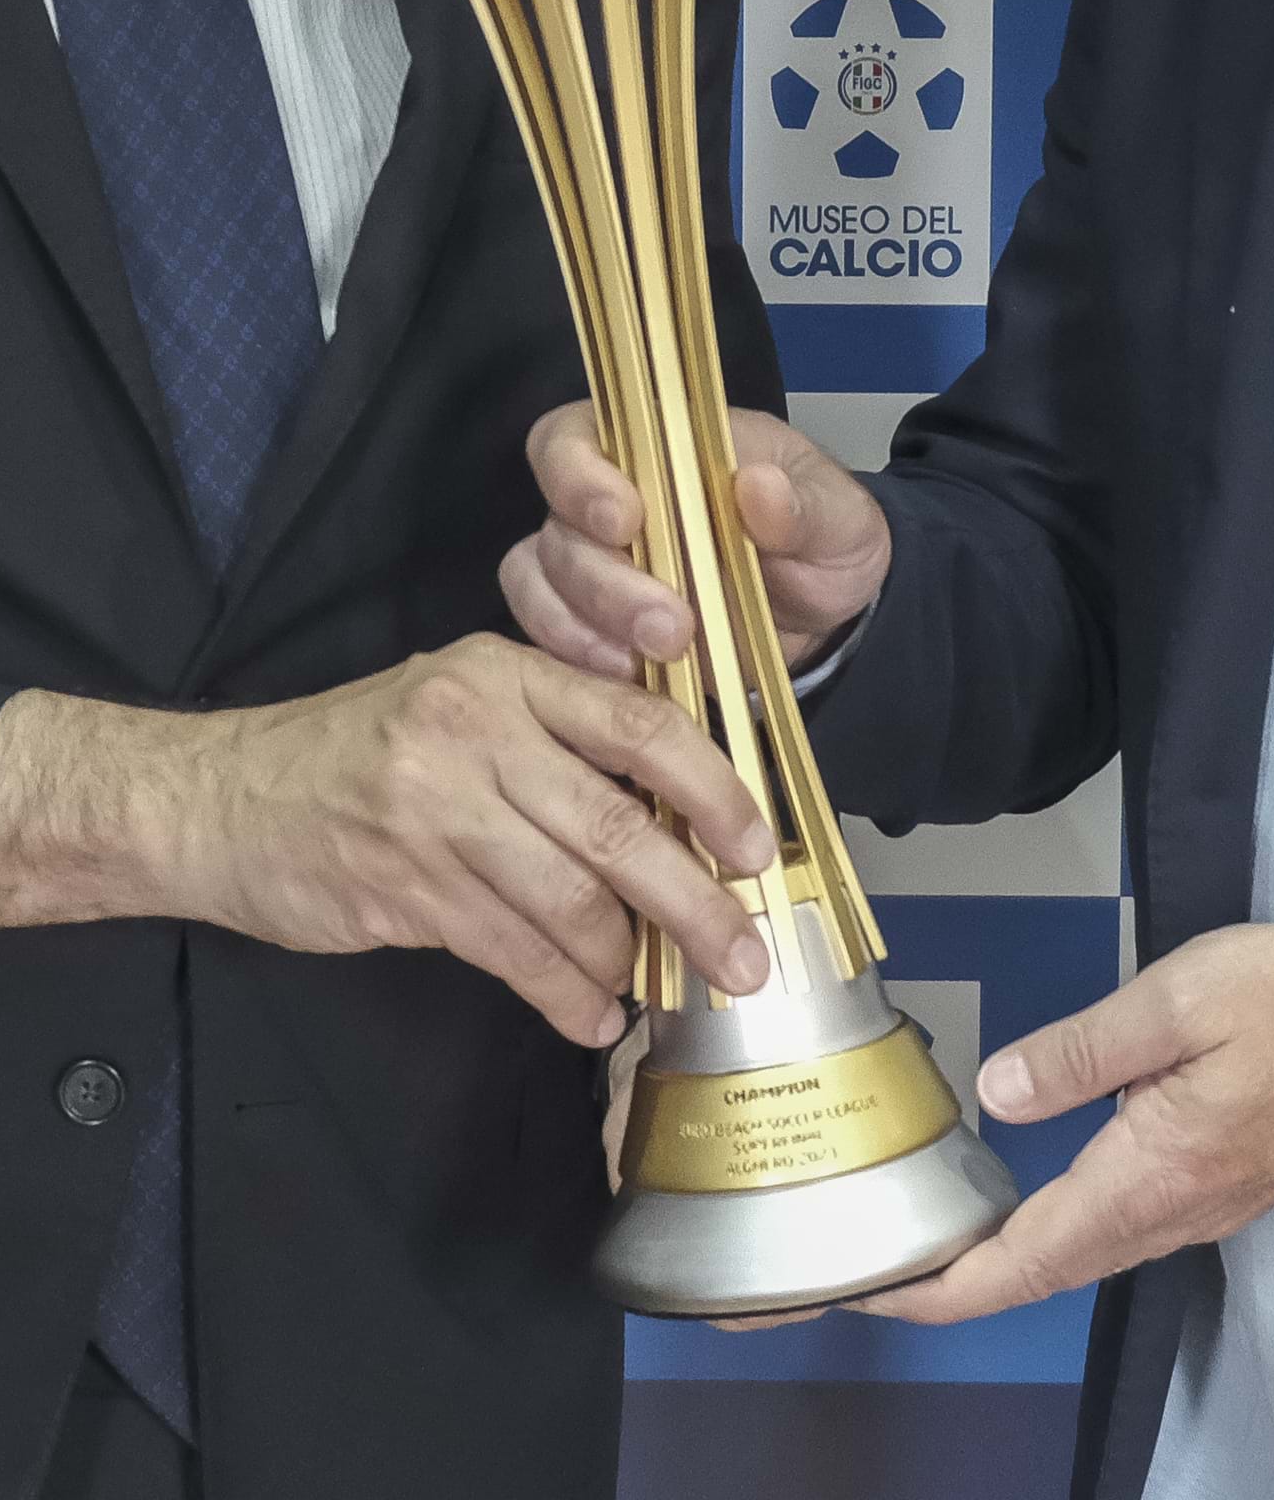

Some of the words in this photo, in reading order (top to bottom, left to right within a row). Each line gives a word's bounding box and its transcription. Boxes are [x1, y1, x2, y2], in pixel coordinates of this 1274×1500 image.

[852, 76, 882, 90] FIGC
[769, 204, 890, 235] MUSEO
[903, 205, 963, 235] DEL
[769, 237, 963, 278] CALCIO
[723, 1077, 821, 1106] CHAMPION
